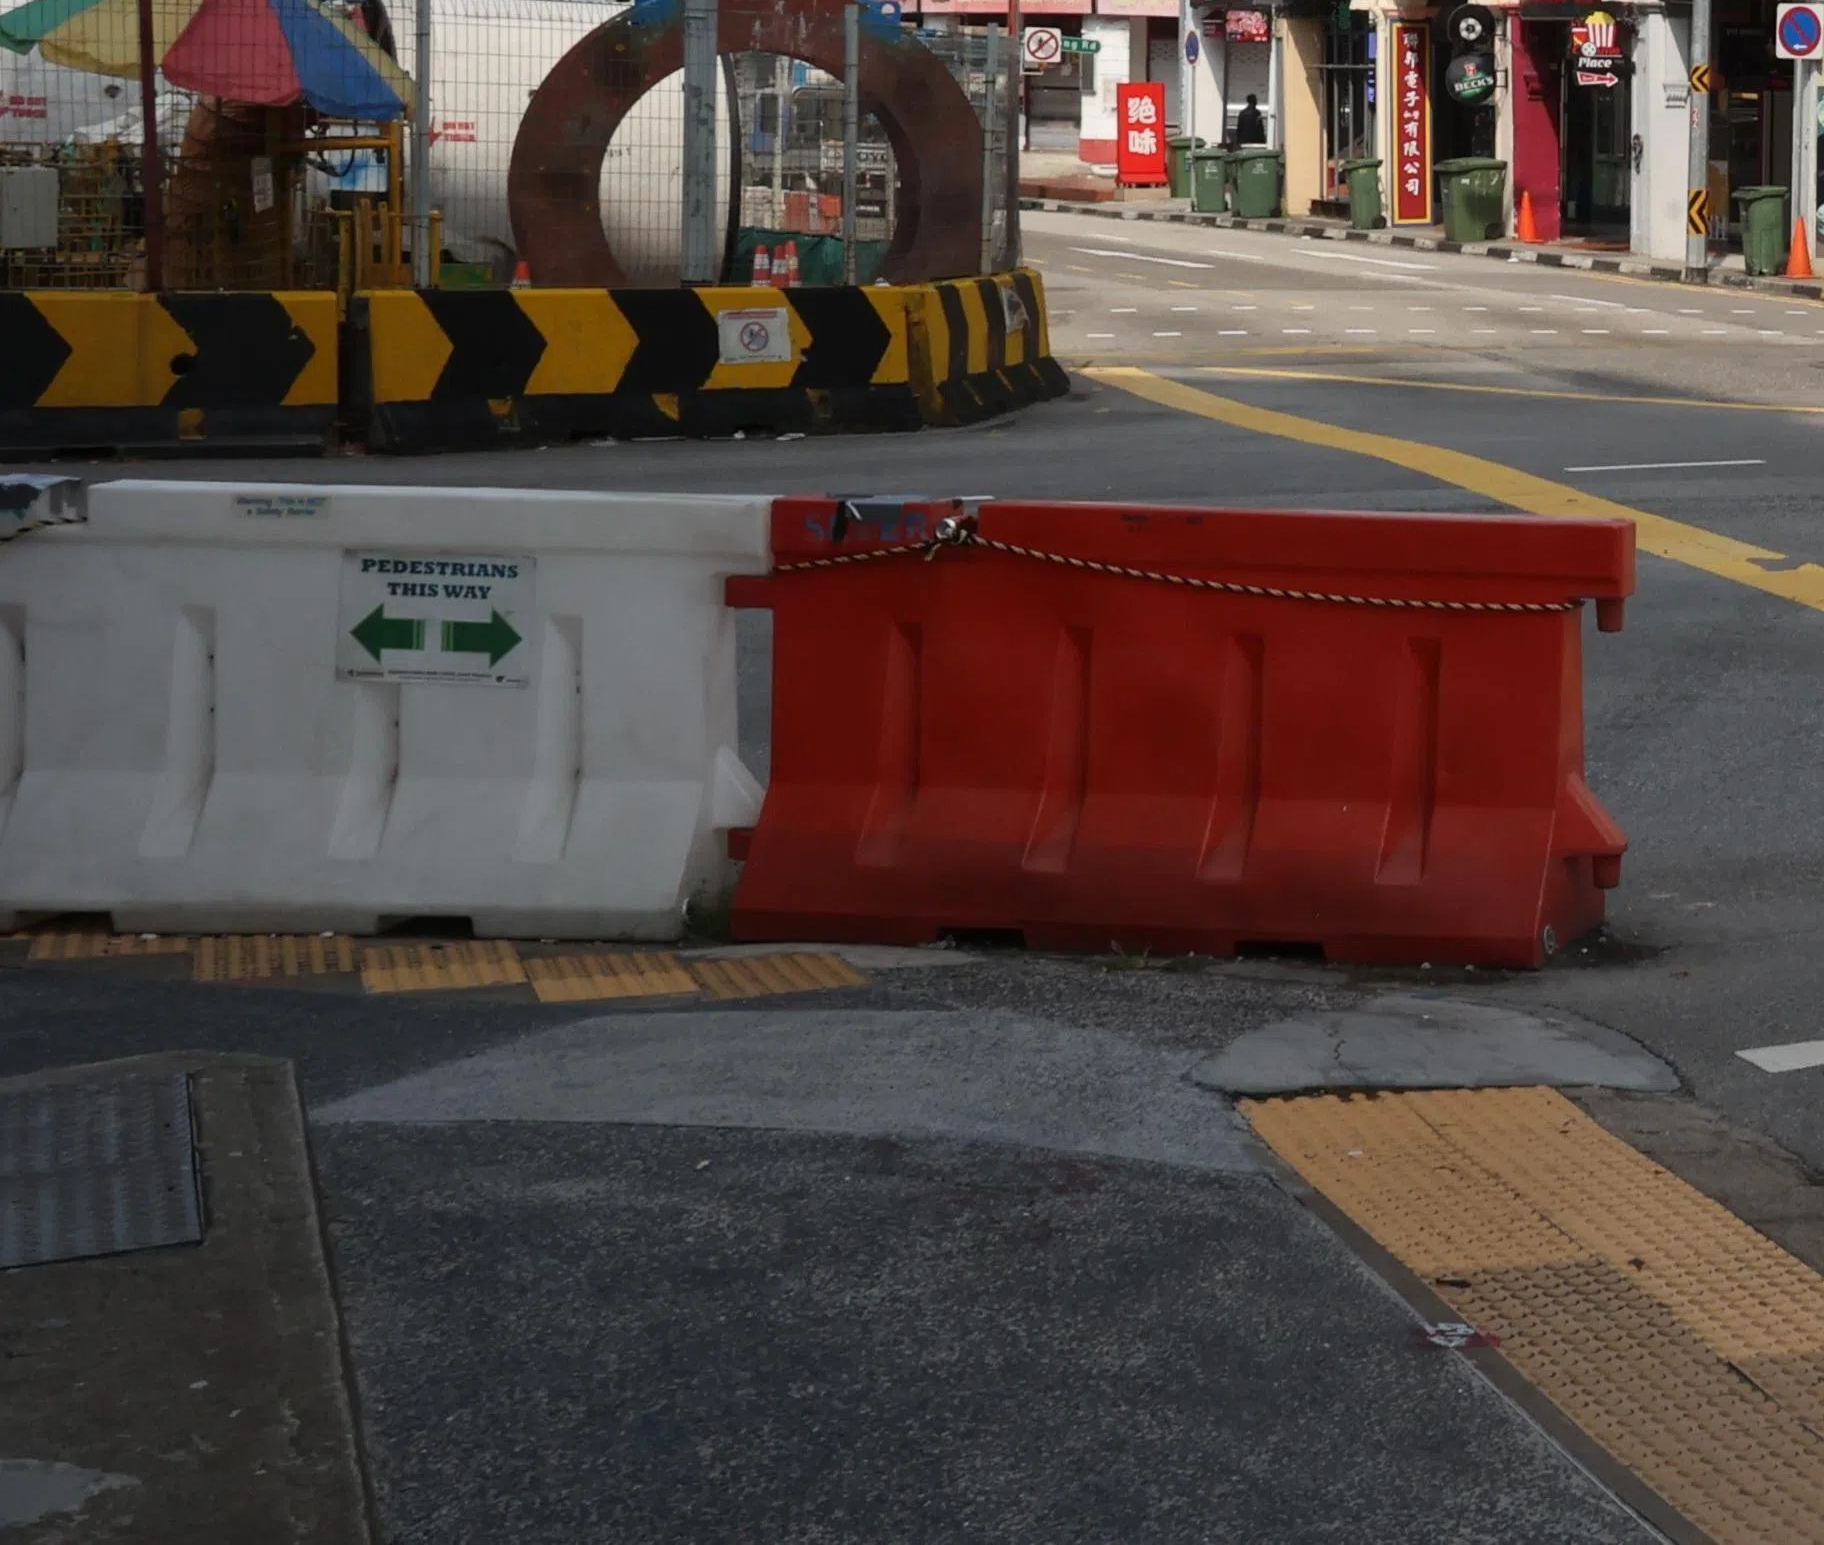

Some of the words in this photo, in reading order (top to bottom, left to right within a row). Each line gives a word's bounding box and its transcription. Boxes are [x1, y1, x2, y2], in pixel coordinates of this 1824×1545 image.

[1578, 56, 1613, 69] Place
[1454, 76, 1495, 92] BECK'S
[1127, 97, 1157, 155] 绝味
[361, 558, 518, 579] PEDESTRIANS
[387, 581, 438, 598] THIS
[443, 584, 492, 600] WAY
